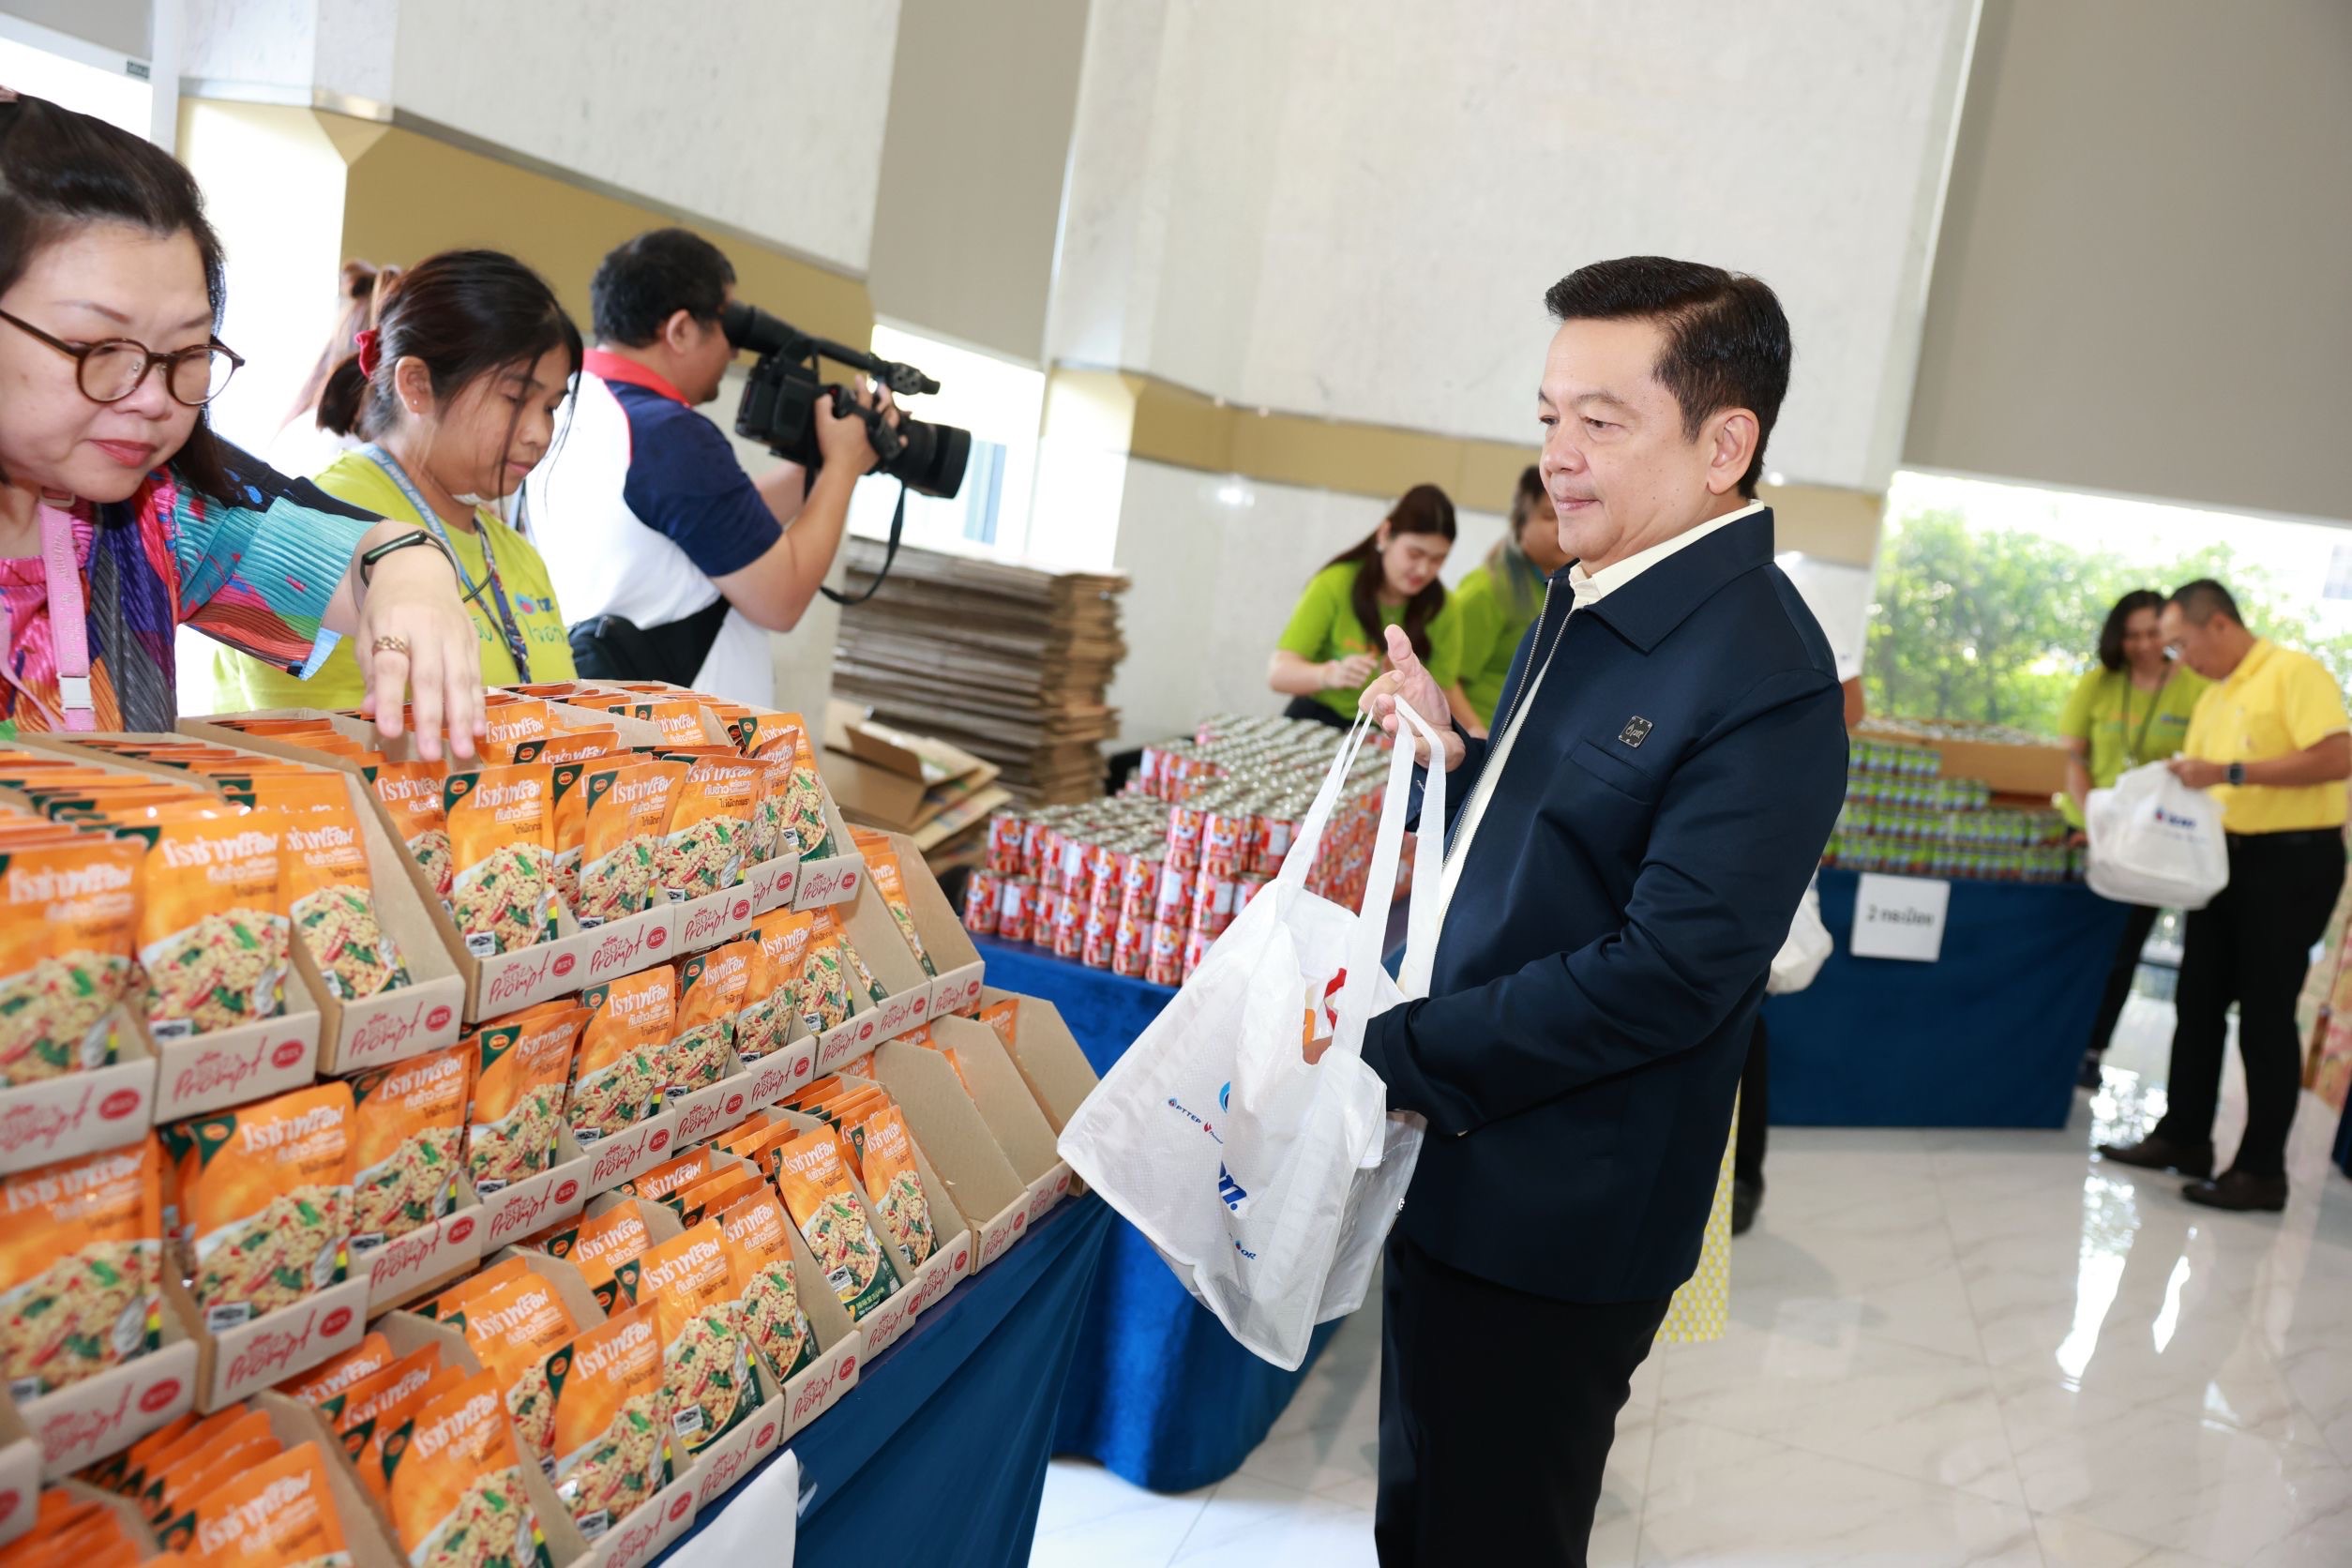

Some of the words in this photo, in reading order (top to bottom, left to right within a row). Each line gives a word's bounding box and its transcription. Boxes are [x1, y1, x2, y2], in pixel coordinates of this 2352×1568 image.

[753, 870, 776, 907] mpt
[802, 867, 843, 901] Prompt
[685, 897, 731, 943] Prompt
[590, 924, 644, 975] Prompt
[489, 951, 550, 1004] Prompt
[608, 984, 669, 1018] โรซ่าพร้อม
[349, 1001, 425, 1058] Prompt
[822, 1021, 860, 1065] Prompt
[752, 1057, 793, 1104] Prompt
[677, 1093, 725, 1140] Prompt
[1176, 1105, 1201, 1123] PTTEP
[592, 1129, 648, 1185] Prompt
[784, 1139, 837, 1175] โรซ่าพร้อม
[490, 1180, 553, 1241] Prompt
[369, 1219, 442, 1290] Prompt
[576, 1218, 644, 1263] โรซ่าพร้อม
[1241, 1248, 1257, 1260] OR
[642, 1238, 721, 1291] โรซ่าพร้อม
[792, 1359, 837, 1424] Prompt
